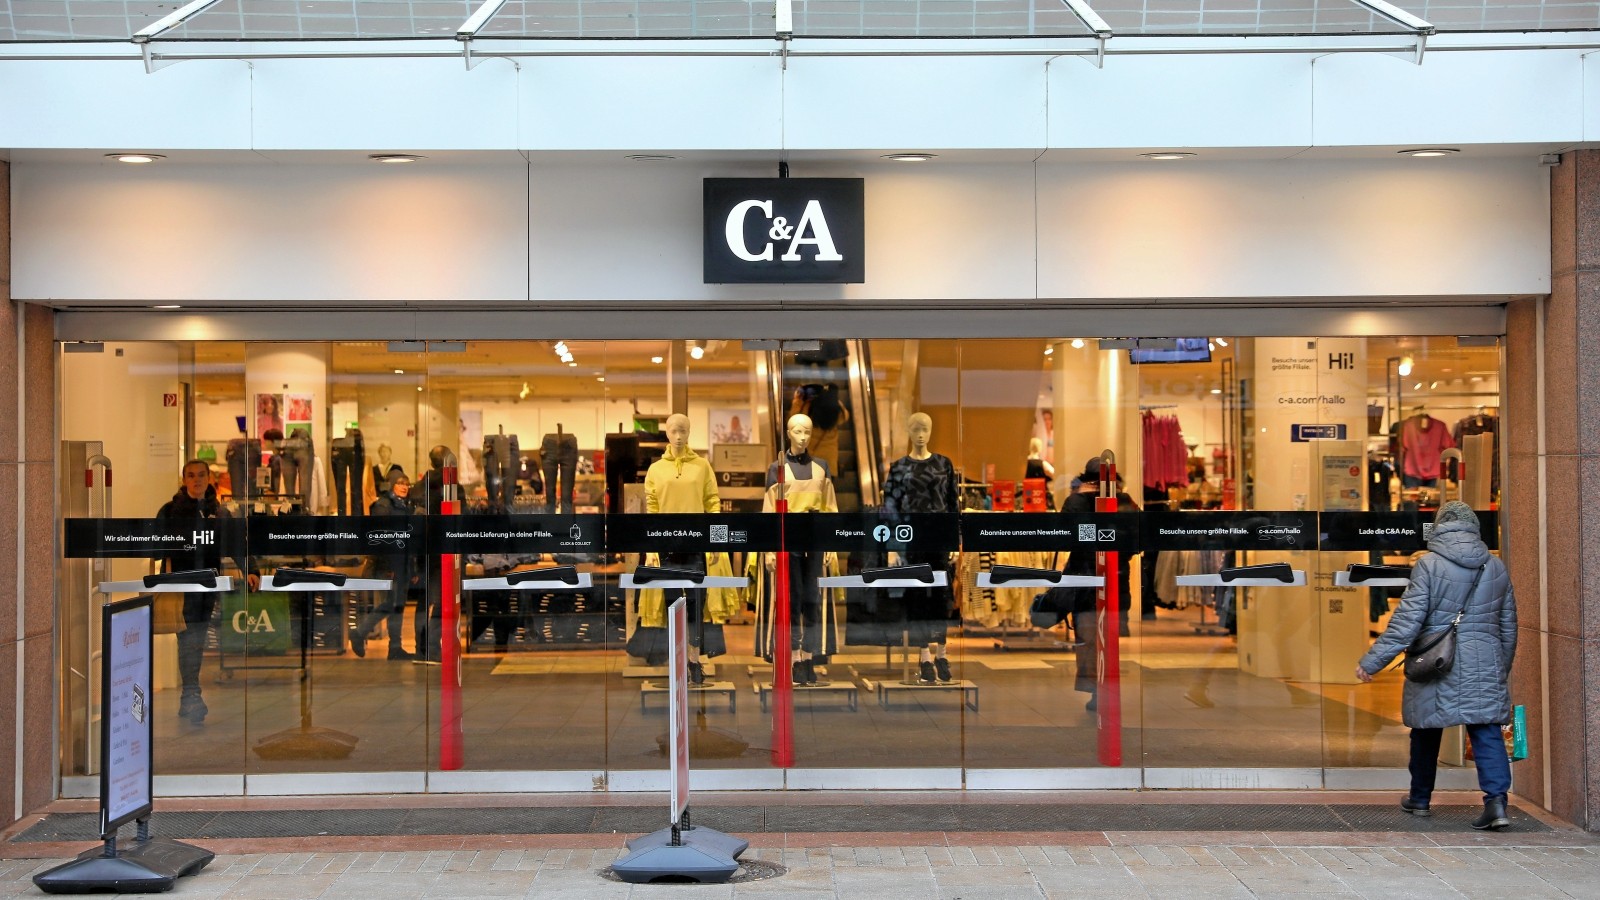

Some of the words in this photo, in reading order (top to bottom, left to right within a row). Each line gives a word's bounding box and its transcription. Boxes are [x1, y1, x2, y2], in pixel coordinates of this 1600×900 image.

[725, 199, 843, 262] C&A
[1329, 352, 1354, 369] Hi!
[1278, 395, 1346, 404] c-a.com/hallo
[193, 530, 215, 545] Hi!
[318, 533, 338, 541] größte
[480, 531, 508, 539] Lieferung
[232, 609, 276, 634] C&A
